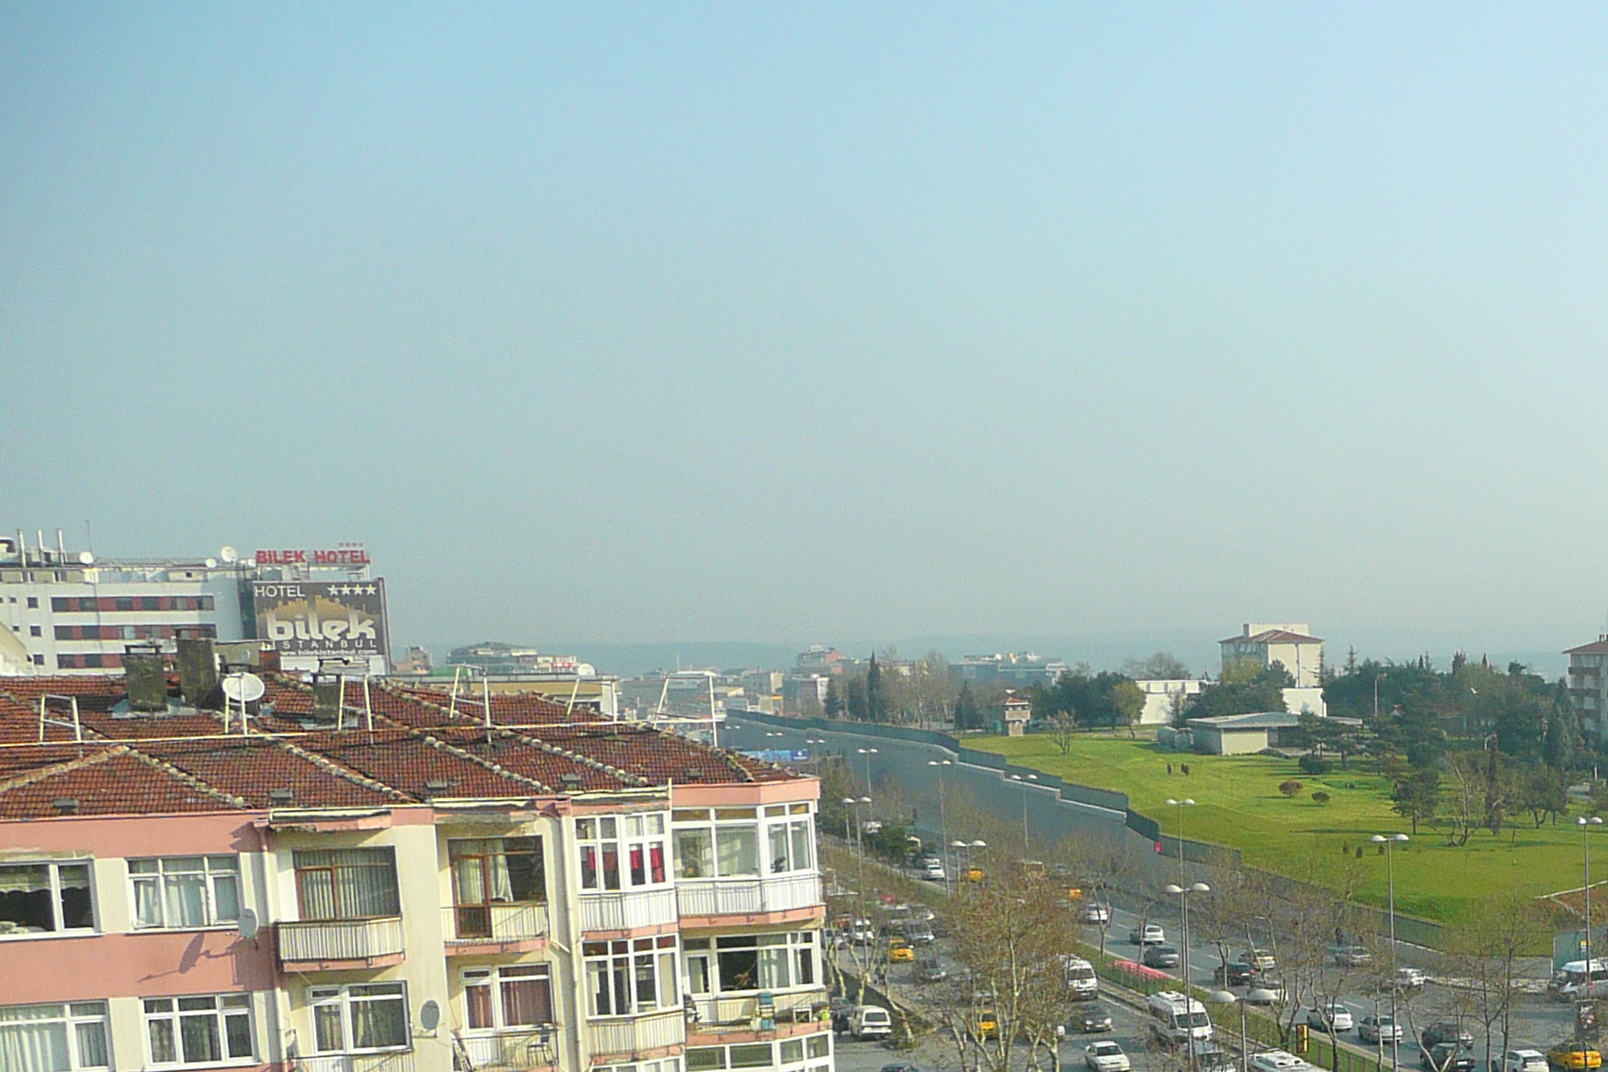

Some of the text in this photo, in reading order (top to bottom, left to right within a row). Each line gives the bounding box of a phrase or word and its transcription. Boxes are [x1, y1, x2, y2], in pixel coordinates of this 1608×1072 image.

[314, 550, 371, 564] HOTEL
[254, 585, 306, 598] HOTEL
[266, 611, 377, 641] bilek
